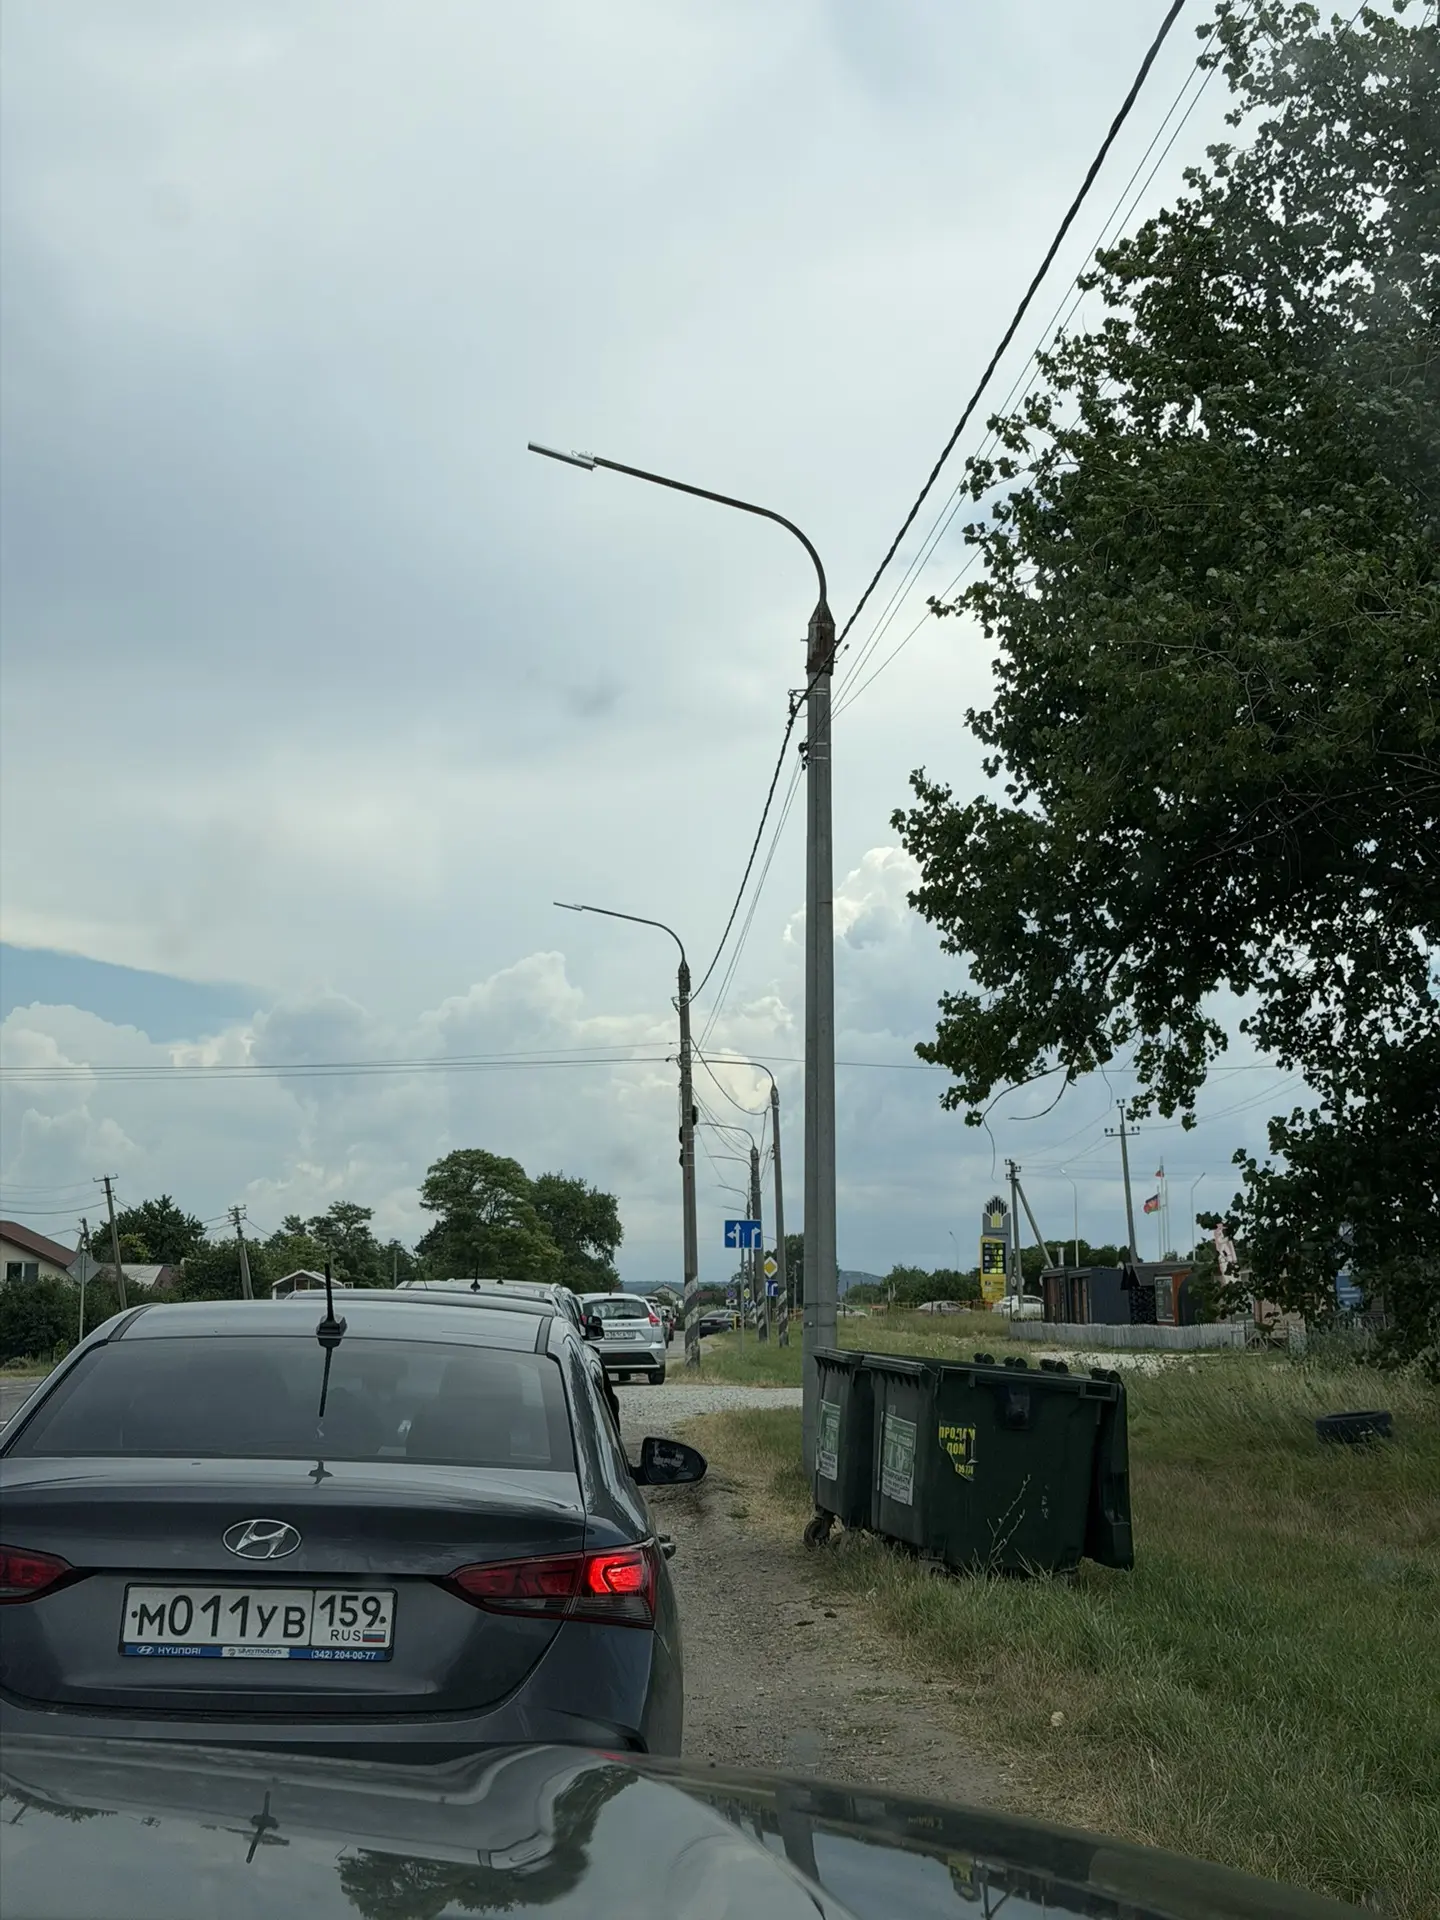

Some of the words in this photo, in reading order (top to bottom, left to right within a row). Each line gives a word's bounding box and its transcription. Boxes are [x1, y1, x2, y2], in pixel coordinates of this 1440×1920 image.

[136, 1594, 306, 1639] М011УВ
[319, 1594, 382, 1628] 159
[330, 1629, 361, 1642] RUS
[157, 1646, 202, 1655] HYUNDAI
[311, 1649, 333, 1659] (342)
[334, 1650, 377, 1660] 204-00-77
